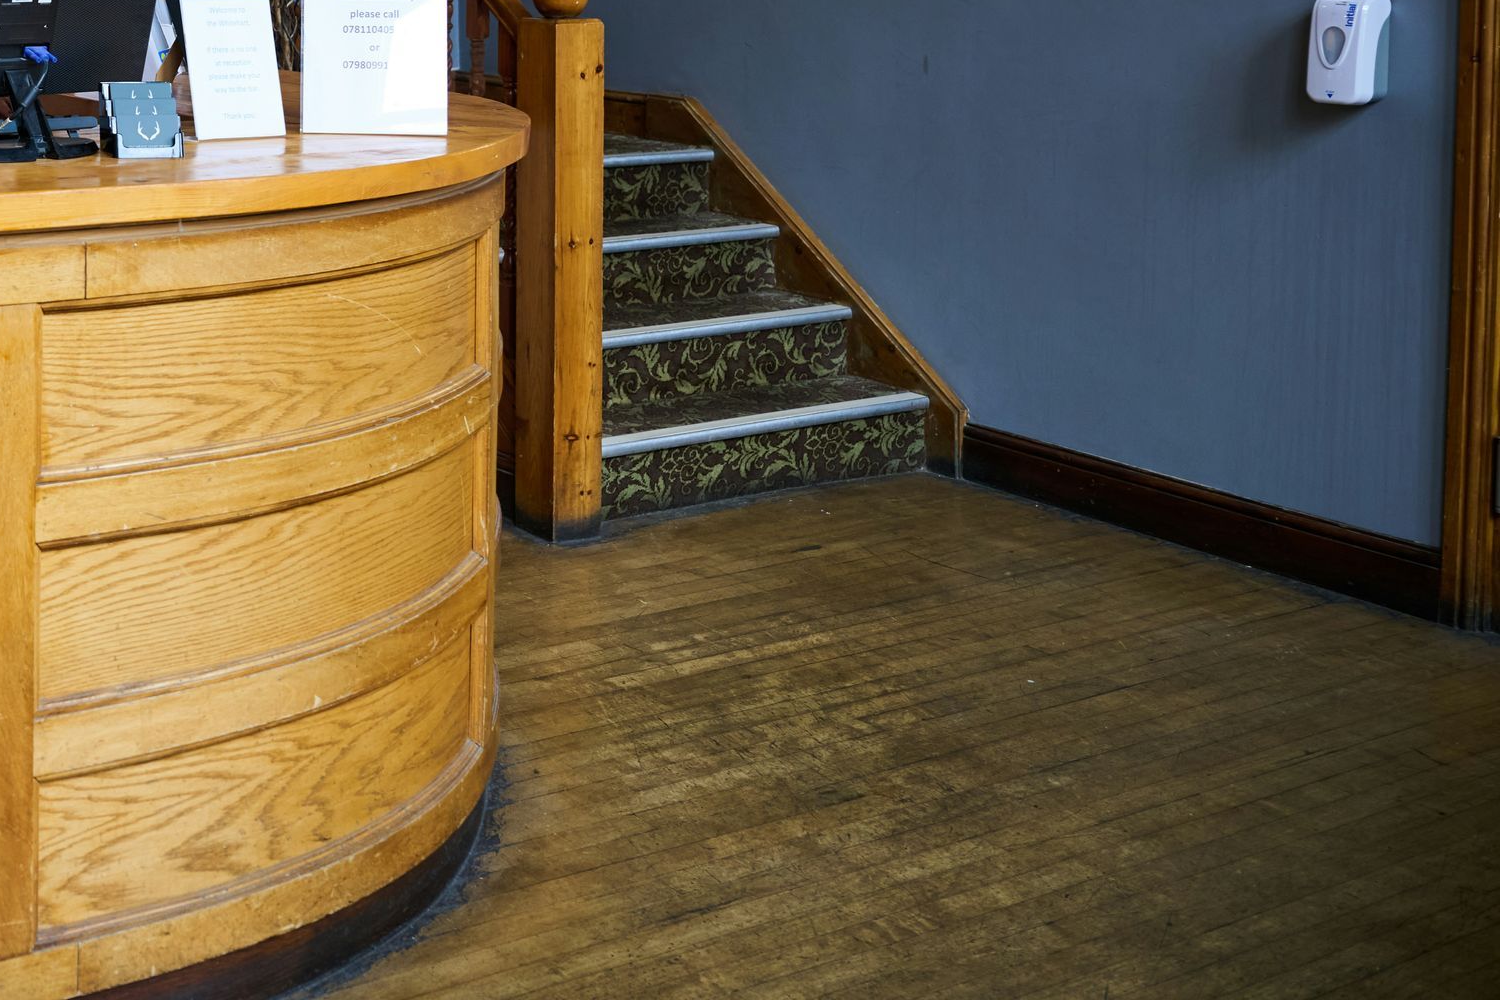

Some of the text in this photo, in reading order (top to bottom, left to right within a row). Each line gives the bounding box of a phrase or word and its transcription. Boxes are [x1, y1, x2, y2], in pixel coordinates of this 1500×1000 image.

[350, 10, 400, 20] please call
[1345, 3, 1357, 27] Initial
[369, 44, 381, 52] or
